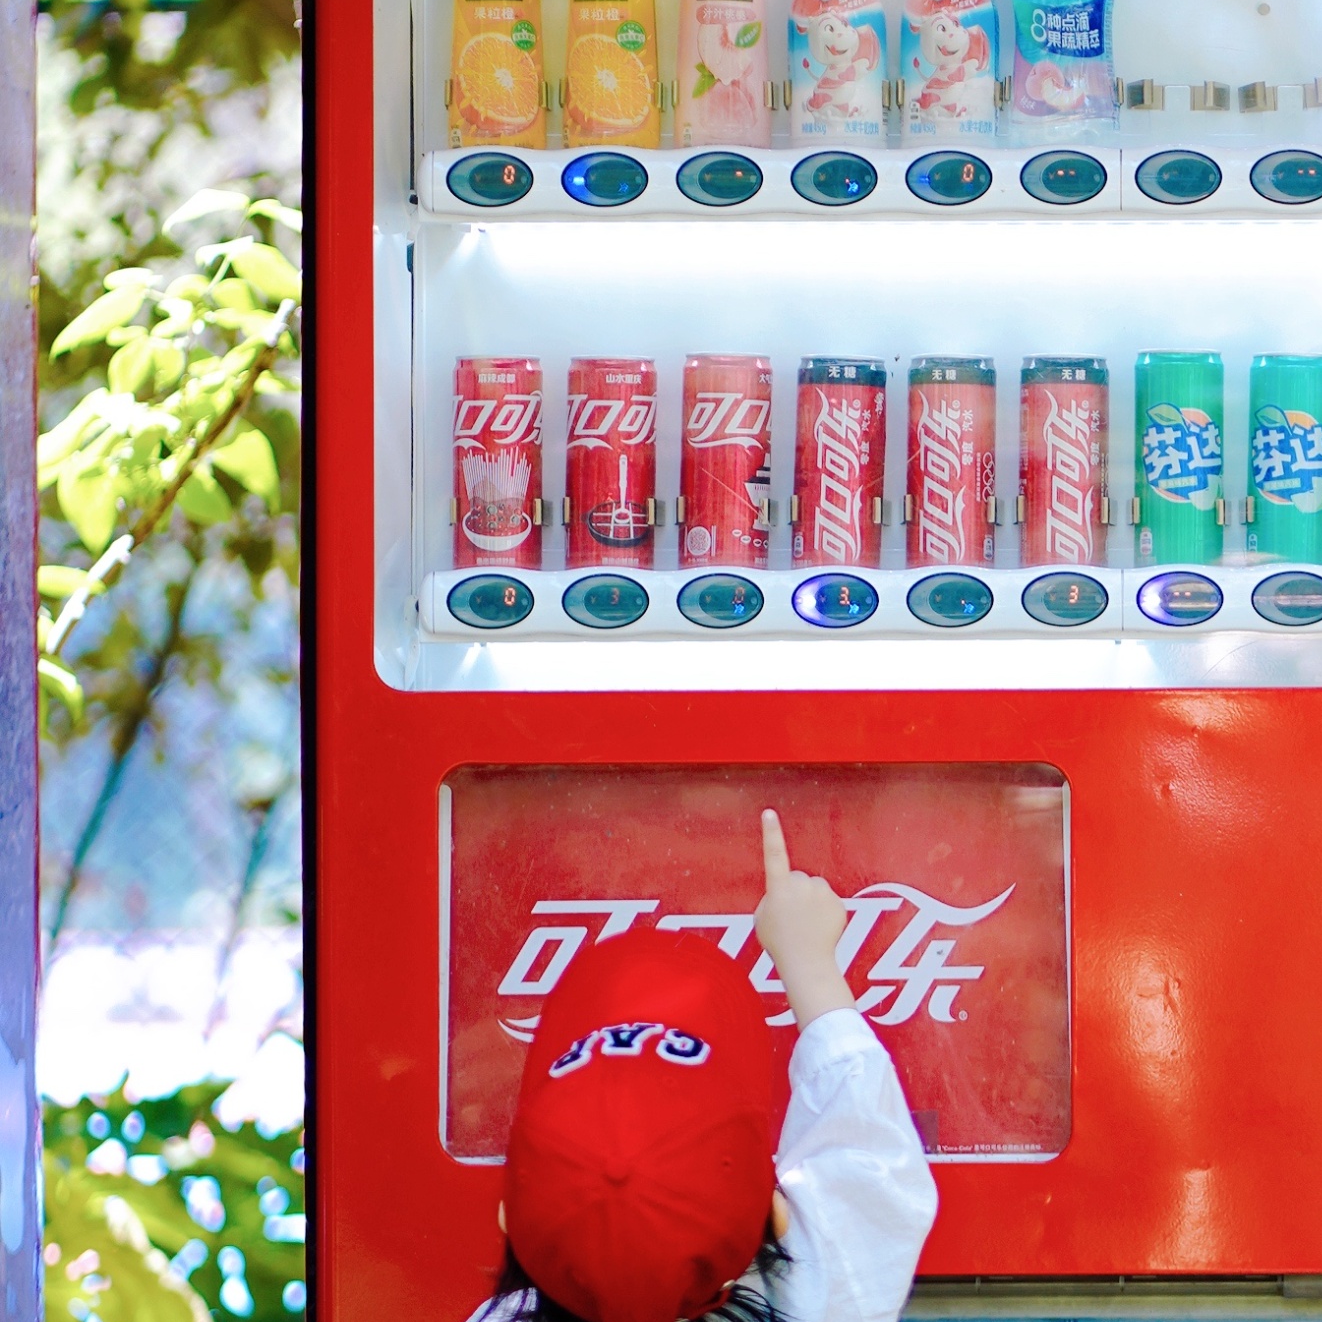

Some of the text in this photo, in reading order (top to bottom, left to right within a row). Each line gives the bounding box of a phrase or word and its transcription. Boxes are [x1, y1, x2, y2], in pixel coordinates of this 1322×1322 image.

[474, 7, 514, 20] 果粒橙
[578, 8, 620, 21] 果粒橙
[828, 365, 856, 379] 无糖
[931, 369, 957, 381] 无糖
[1061, 369, 1086, 381] 无糖
[1143, 425, 1222, 483] 芬达
[814, 387, 862, 563] 可口可乐
[917, 389, 966, 564] 可口可乐
[1042, 389, 1094, 564] 可口可乐
